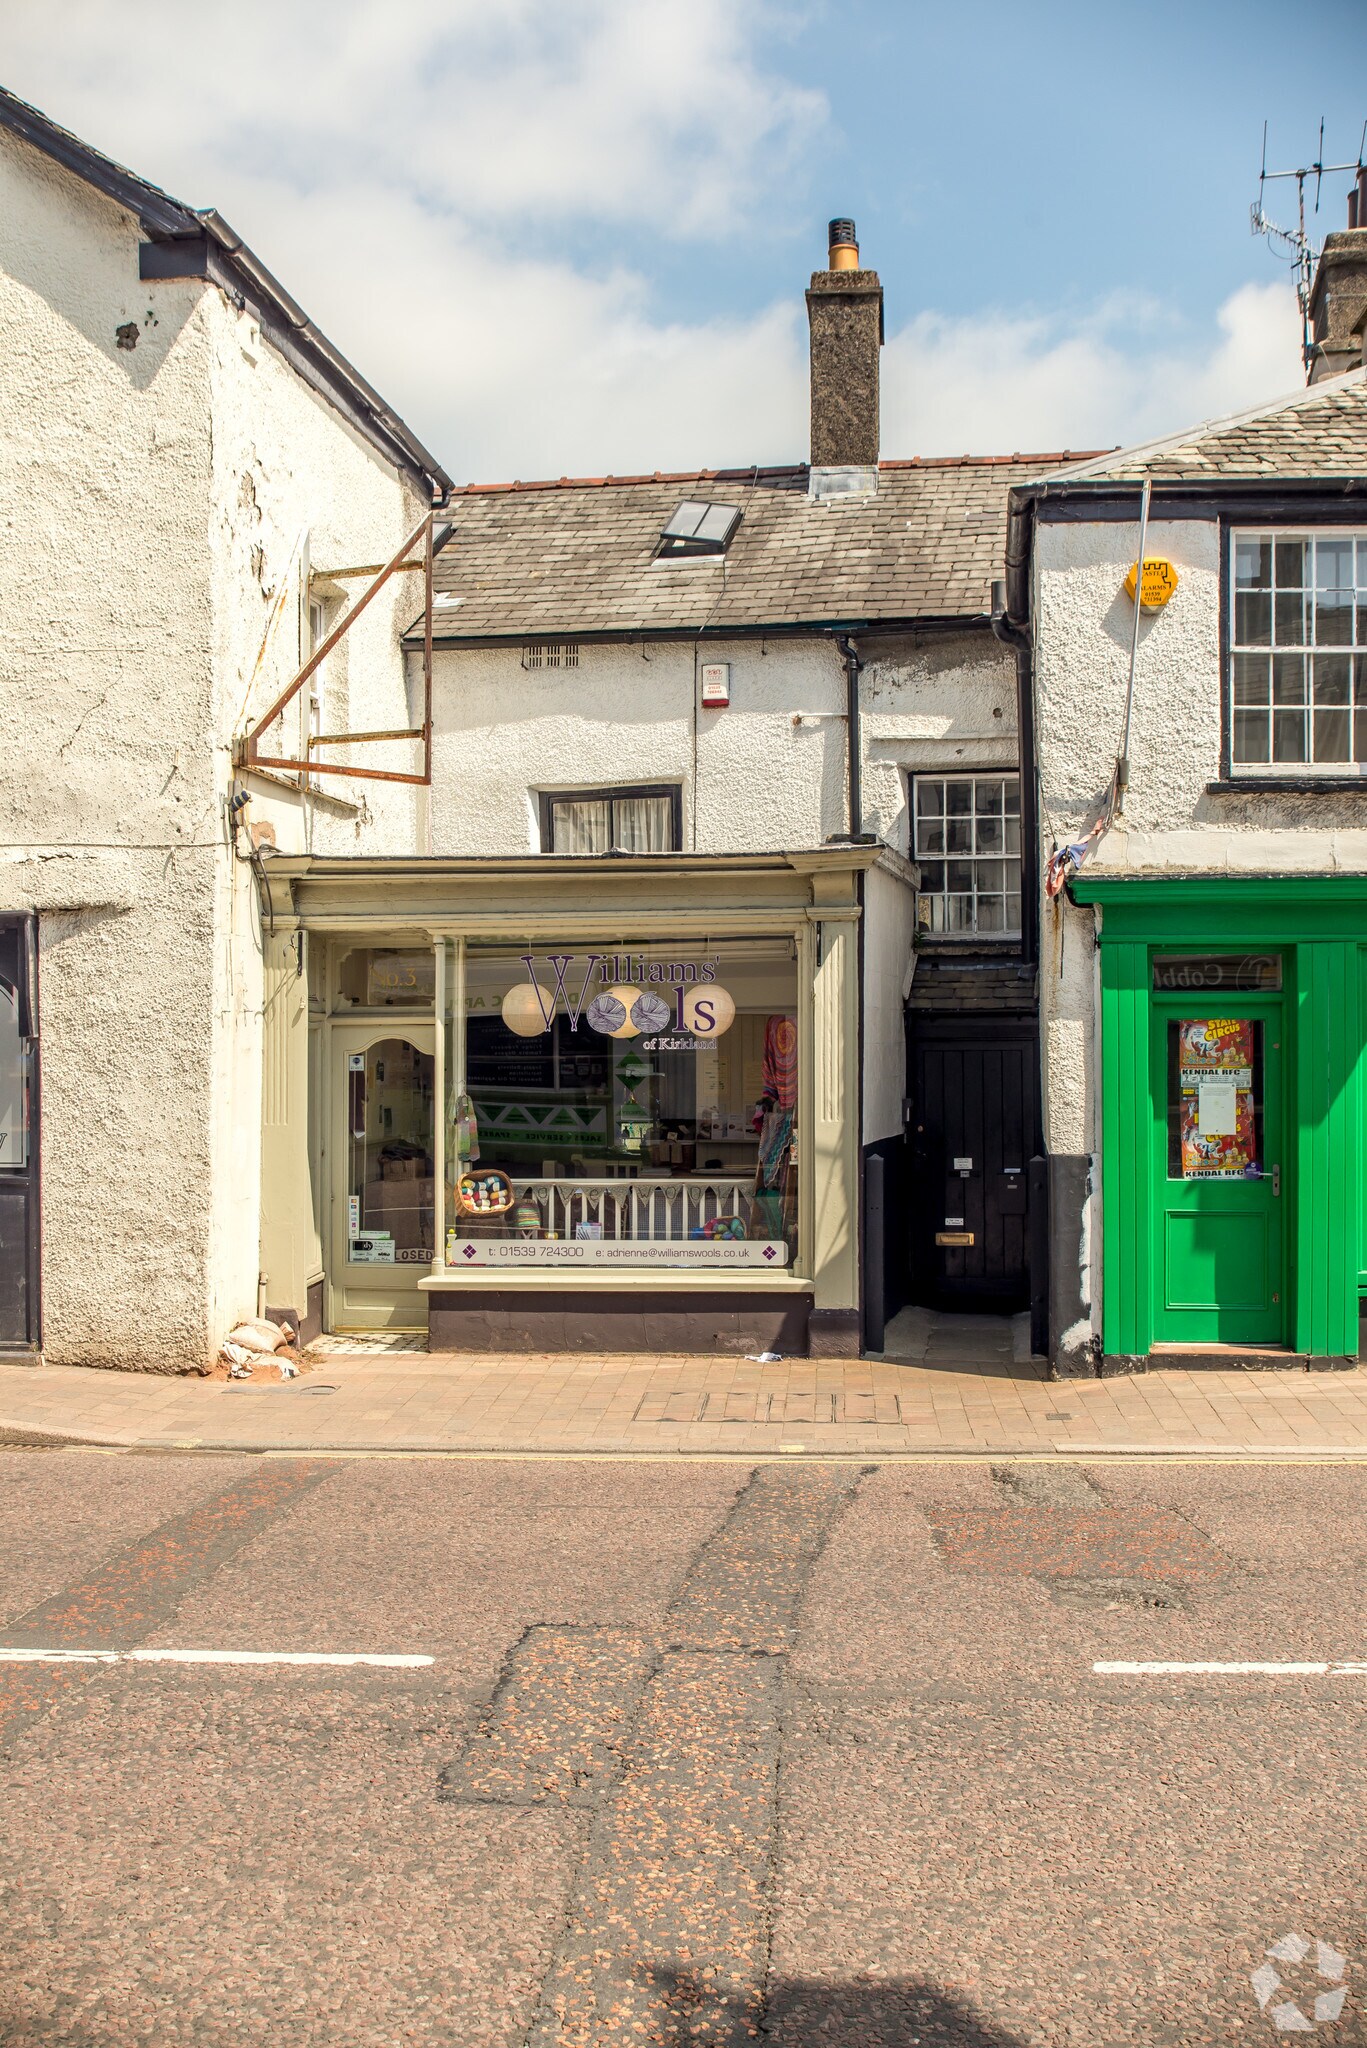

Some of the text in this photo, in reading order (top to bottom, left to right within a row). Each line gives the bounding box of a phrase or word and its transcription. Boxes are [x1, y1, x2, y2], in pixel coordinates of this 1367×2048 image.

[1204, 1023, 1241, 1042] CIRCUS
[643, 1038, 717, 1050] of Kirkland
[395, 1250, 433, 1260] LOSED
[500, 1246, 536, 1257] 01539
[540, 1246, 584, 1257] 724300
[595, 1249, 605, 1257] e:
[607, 1247, 750, 1258] adrienne@williamswools.co.uk
